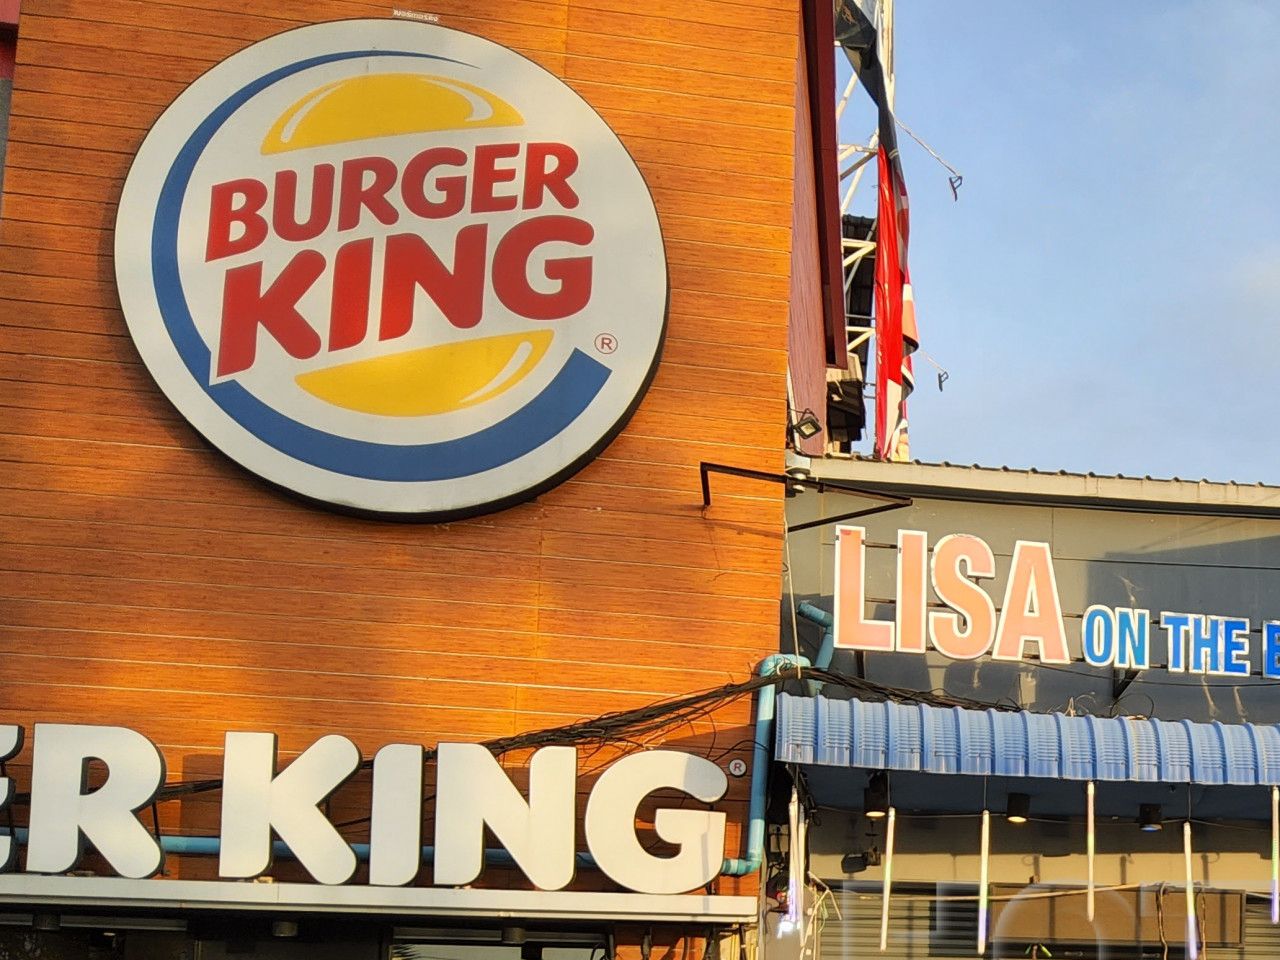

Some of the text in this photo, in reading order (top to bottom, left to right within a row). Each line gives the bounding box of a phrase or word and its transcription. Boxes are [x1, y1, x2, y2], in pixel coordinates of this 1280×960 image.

[205, 142, 580, 263] BURGER
[216, 214, 595, 378] KING
[833, 524, 1071, 664] LISA
[1081, 604, 1150, 669] ON
[1159, 611, 1250, 677] THE
[0, 724, 730, 894] R KING
